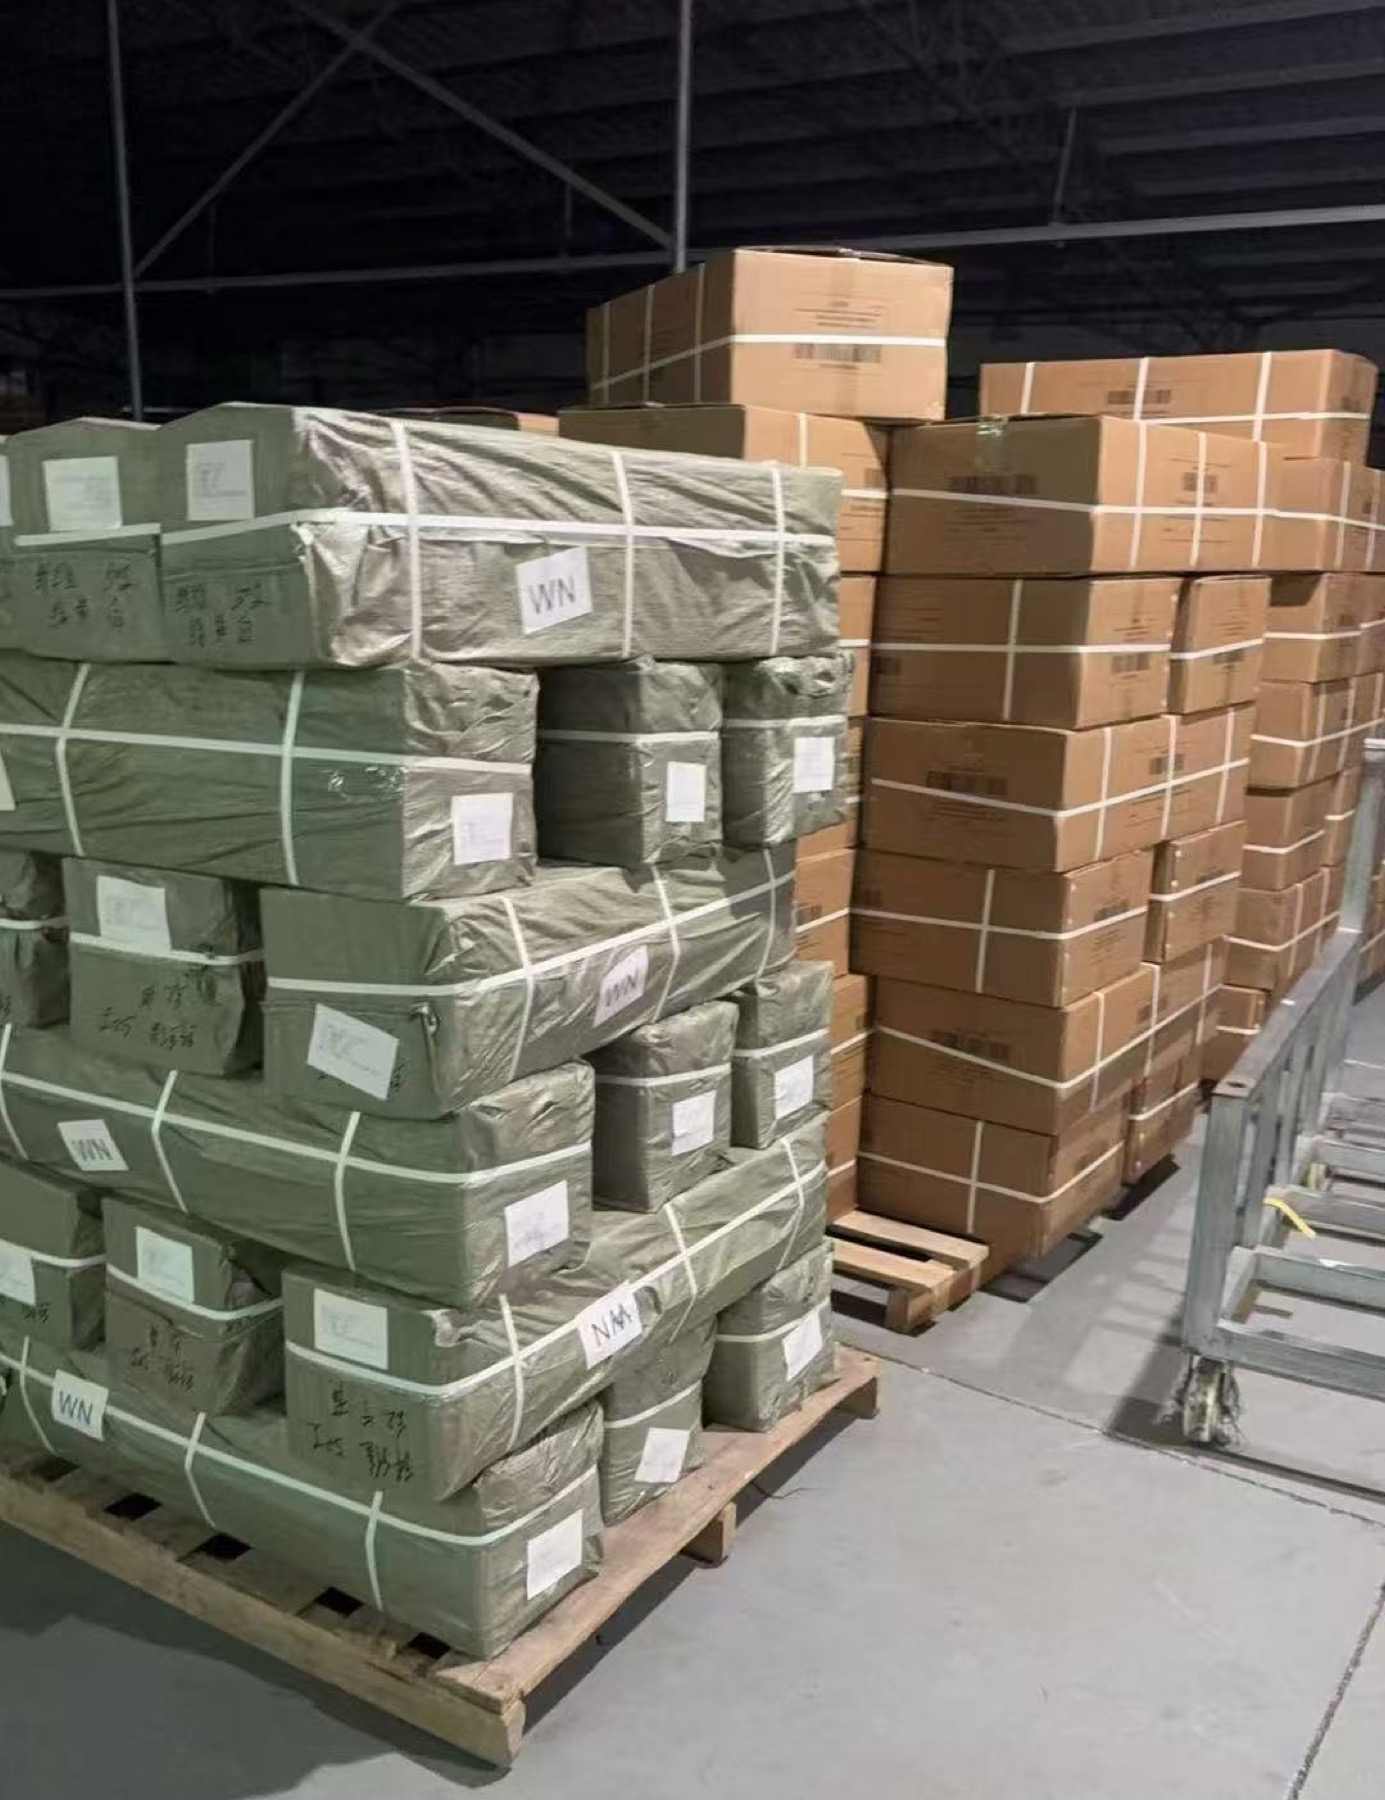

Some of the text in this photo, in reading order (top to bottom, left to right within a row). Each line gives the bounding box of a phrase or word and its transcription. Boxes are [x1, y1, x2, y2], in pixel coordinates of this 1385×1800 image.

[528, 575, 576, 614] WN
[604, 967, 639, 1007] WN
[71, 1138, 113, 1161] WN
[60, 1390, 93, 1425] WN
